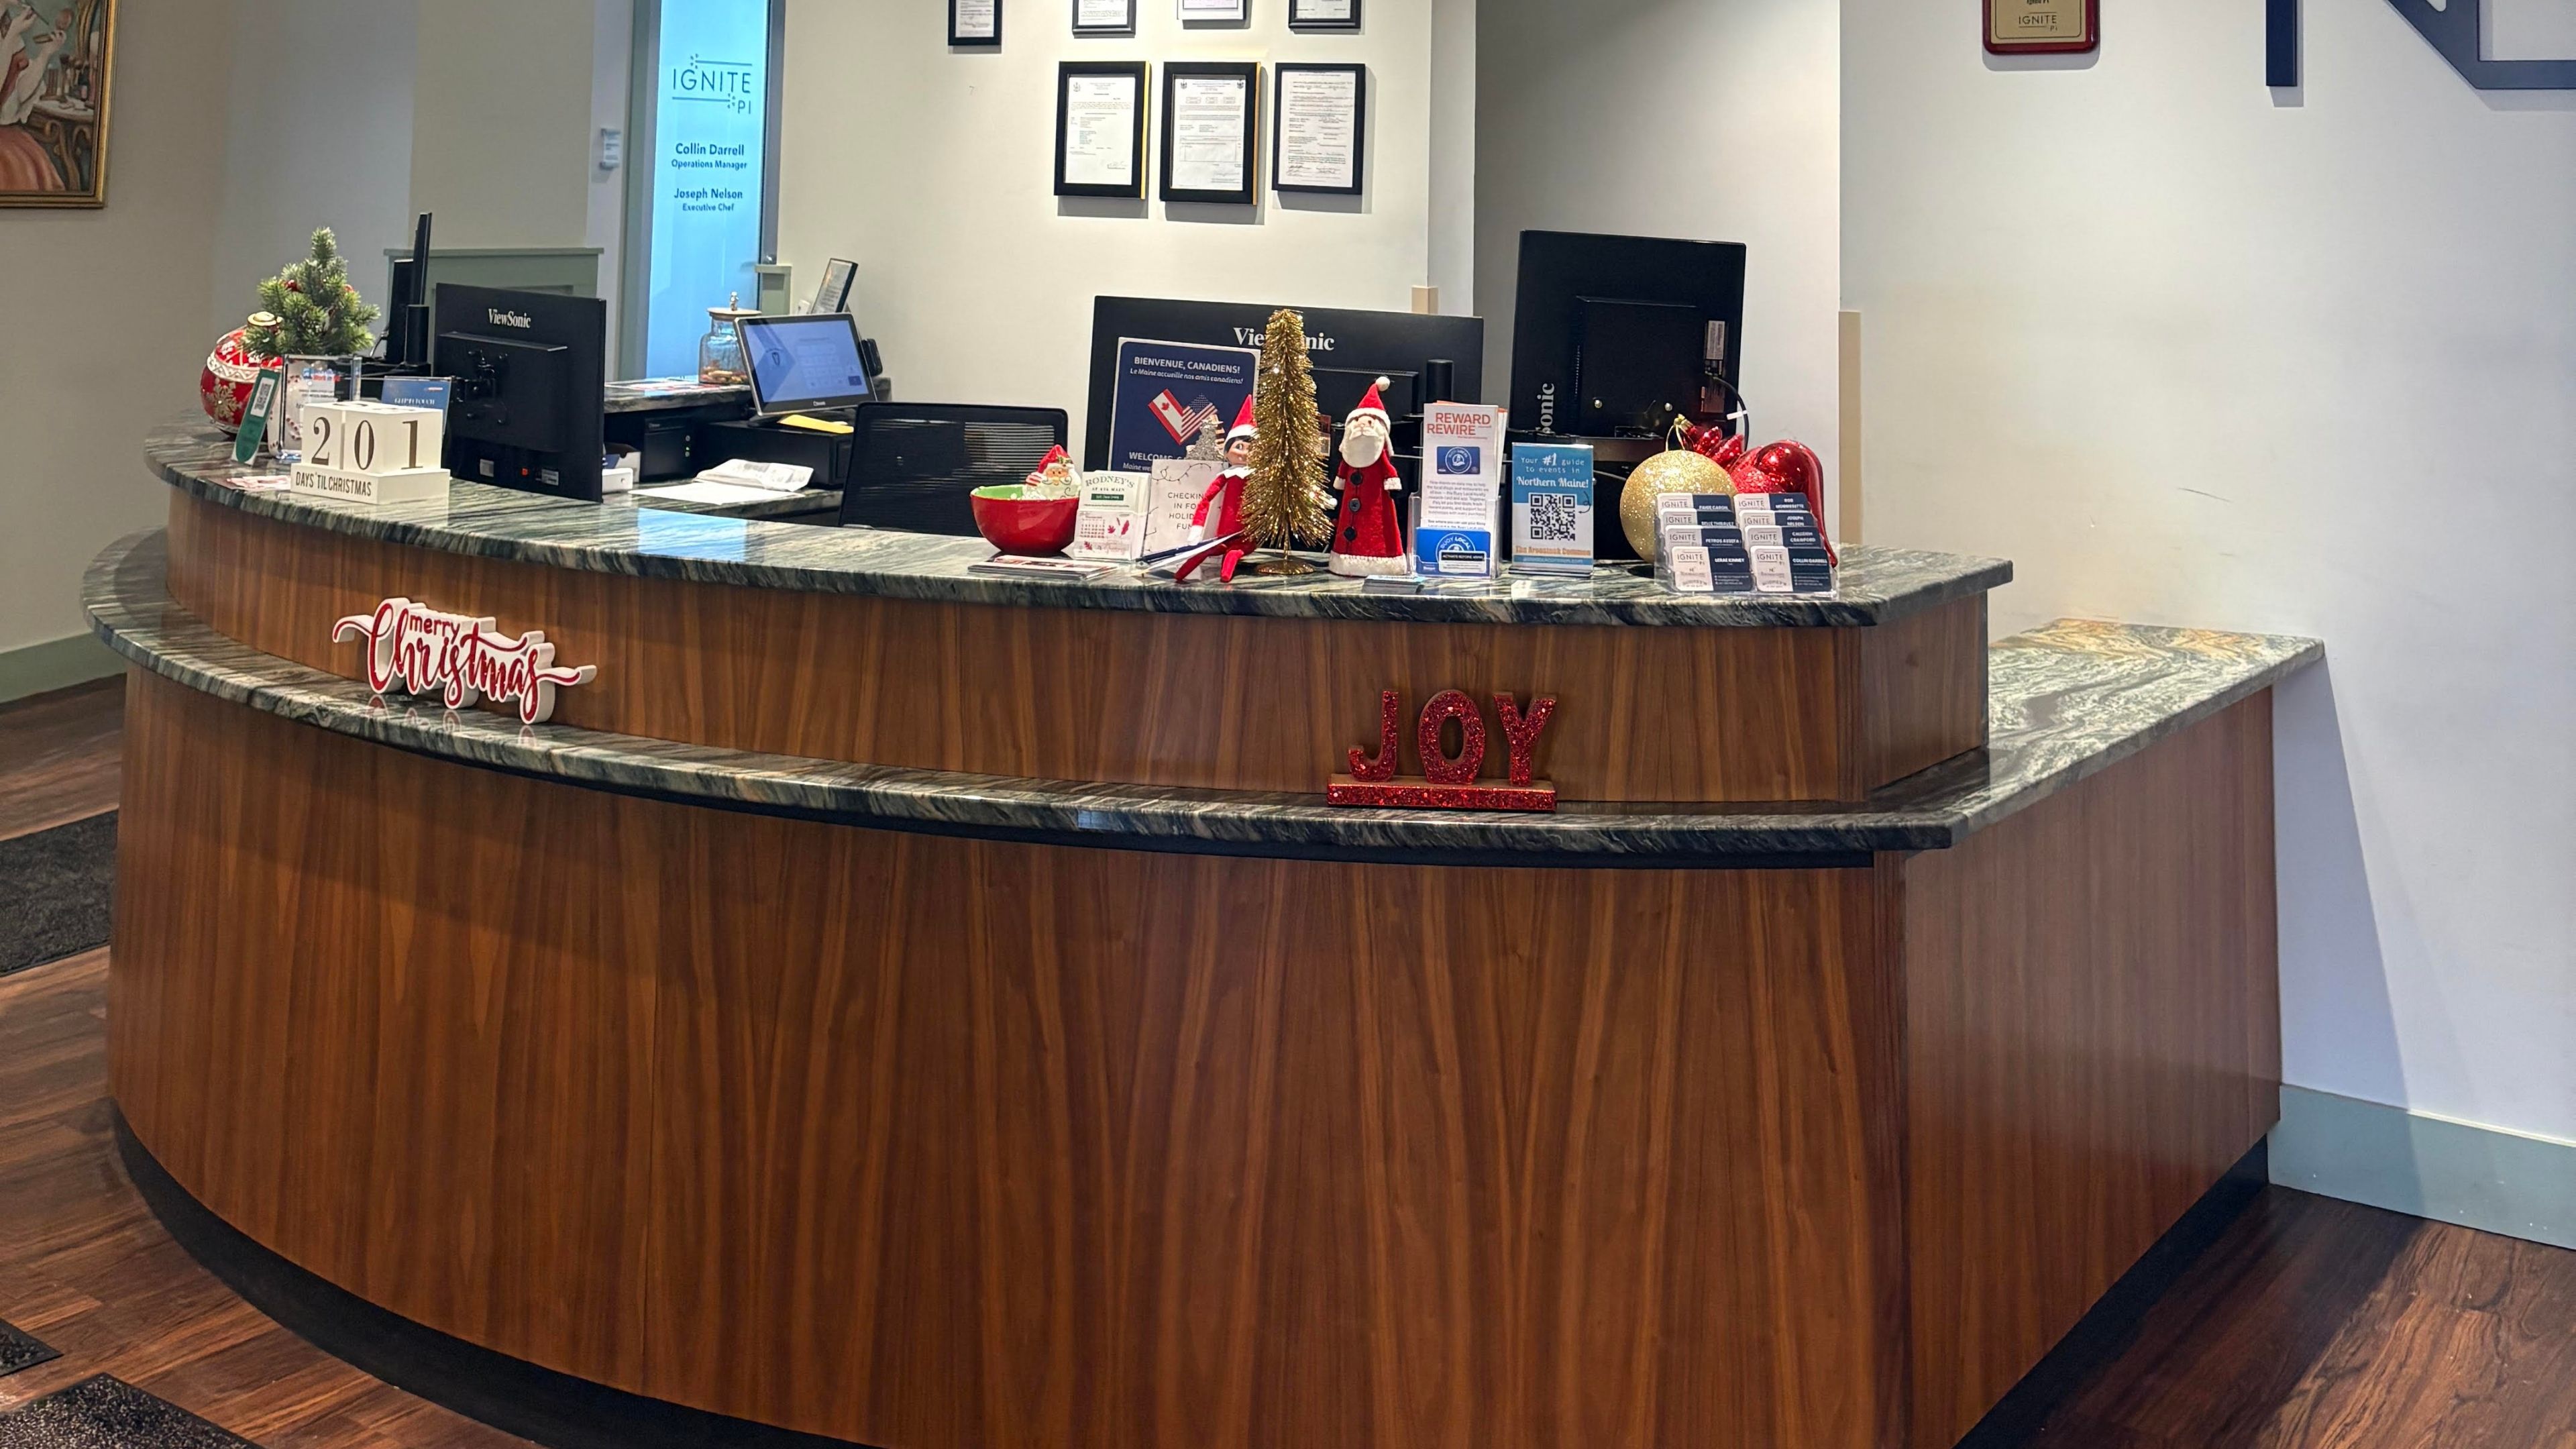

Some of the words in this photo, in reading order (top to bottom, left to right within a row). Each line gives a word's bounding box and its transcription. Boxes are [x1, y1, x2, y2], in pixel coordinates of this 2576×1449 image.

[2019, 15, 2057, 25] IGNITE
[673, 68, 751, 94] IGNITE
[737, 100, 751, 115] PI
[676, 142, 706, 155] Collin
[709, 144, 745, 156] Darrell
[672, 158, 713, 170] Operations
[715, 160, 747, 171] Manager
[674, 187, 708, 201] Joseph
[711, 187, 743, 199] Nelson
[682, 203, 716, 211] Executive
[718, 203, 735, 211] Chef
[488, 308, 531, 329] ViewSonic
[1233, 327, 1335, 351] Vienic
[1134, 356, 1186, 370] BIENVENUE,
[1187, 361, 1240, 374] CANADIENS!
[1157, 370, 1183, 379] accueille
[1210, 376, 1244, 384] canadiens!
[1435, 412, 1491, 425] REWARD
[1427, 423, 1477, 435] REWIRE
[1542, 452, 1557, 466] #1
[296, 471, 315, 488] DAYS
[328, 476, 372, 496] CHRISTMAS
[1085, 475, 1135, 488] RODNEY'S
[1516, 476, 1556, 486] Northern
[1558, 478, 1589, 488] Maine!
[1454, 536, 1471, 549] LOCAL
[409, 612, 461, 645] merry
[333, 601, 582, 723] Christmas
[1348, 689, 1557, 787] JOY
